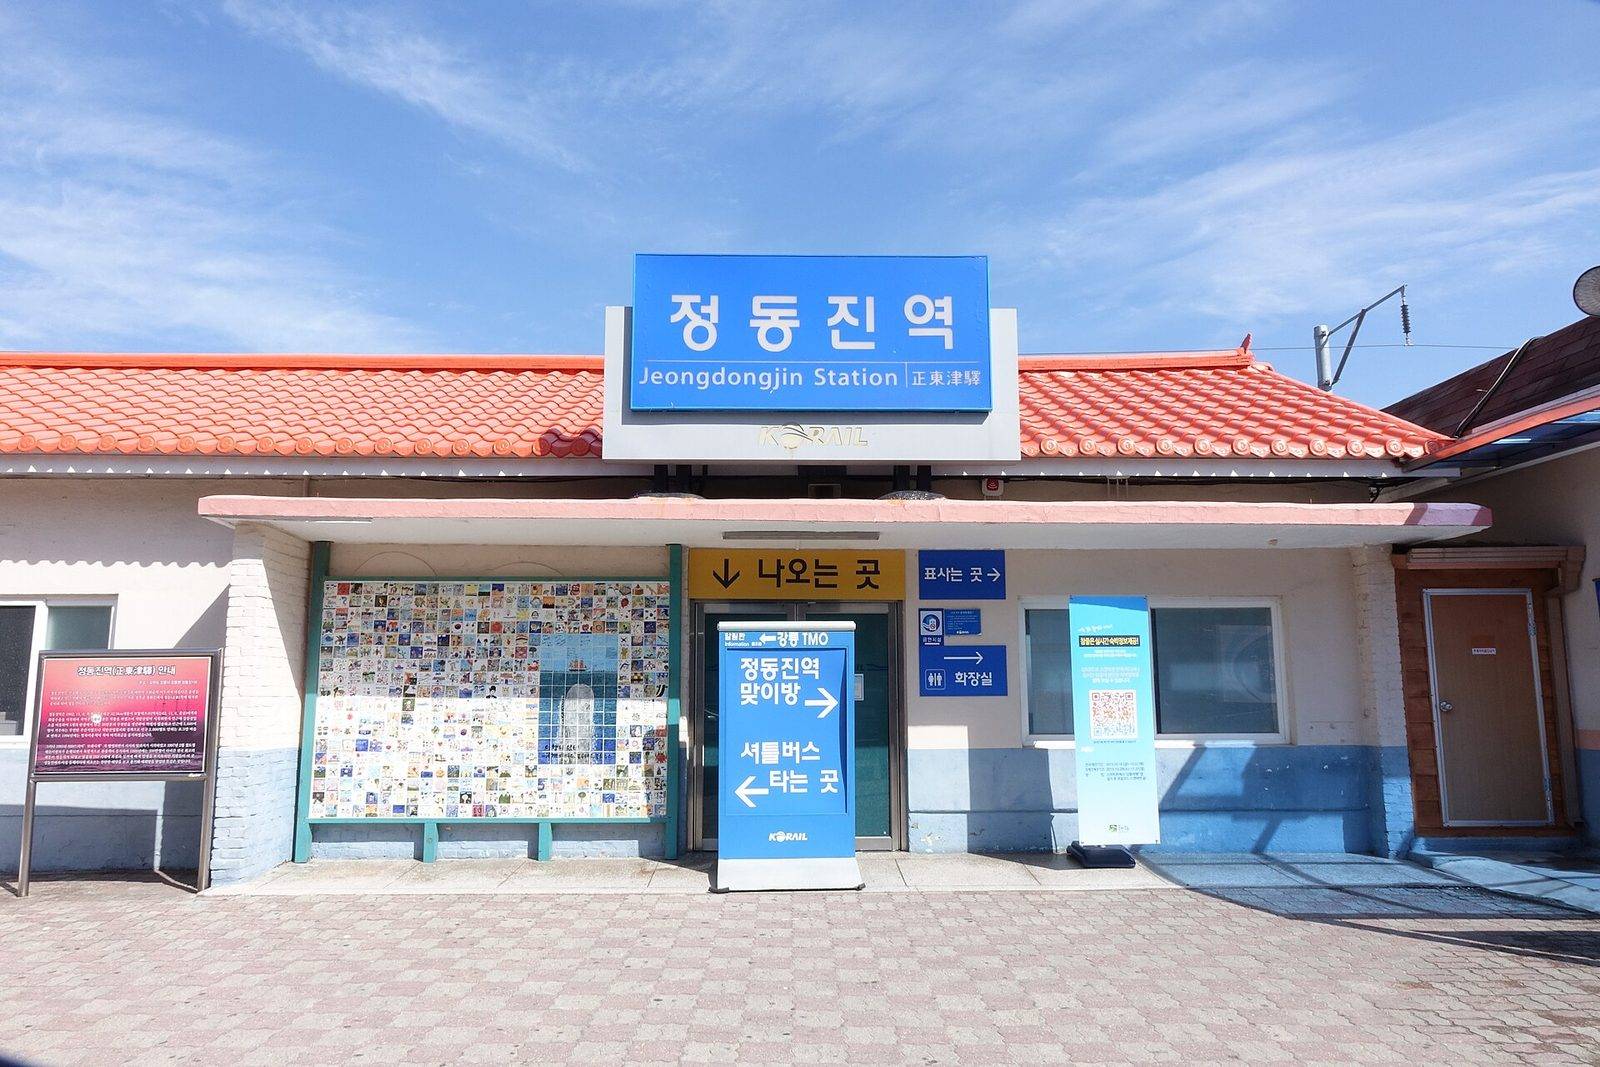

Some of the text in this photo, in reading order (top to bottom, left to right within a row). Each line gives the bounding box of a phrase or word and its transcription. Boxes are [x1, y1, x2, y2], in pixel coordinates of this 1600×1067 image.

[670, 294, 954, 352] 정동진역
[639, 366, 898, 391] Jeongdongjin Station
[911, 370, 981, 386] 正東津驛
[758, 422, 869, 450] KORAIL
[758, 558, 880, 590] 나오는 곳
[923, 567, 983, 583] 표사는 곳
[777, 632, 829, 648] 강릉 TMO
[158, 665, 176, 675] 안내
[740, 657, 820, 680] 정동진역
[954, 671, 993, 687] 화장실
[740, 682, 801, 706] 맞이방
[740, 741, 821, 765] 셔틀버스
[769, 769, 839, 794] 타는 곳
[768, 831, 808, 842] KORAIL
